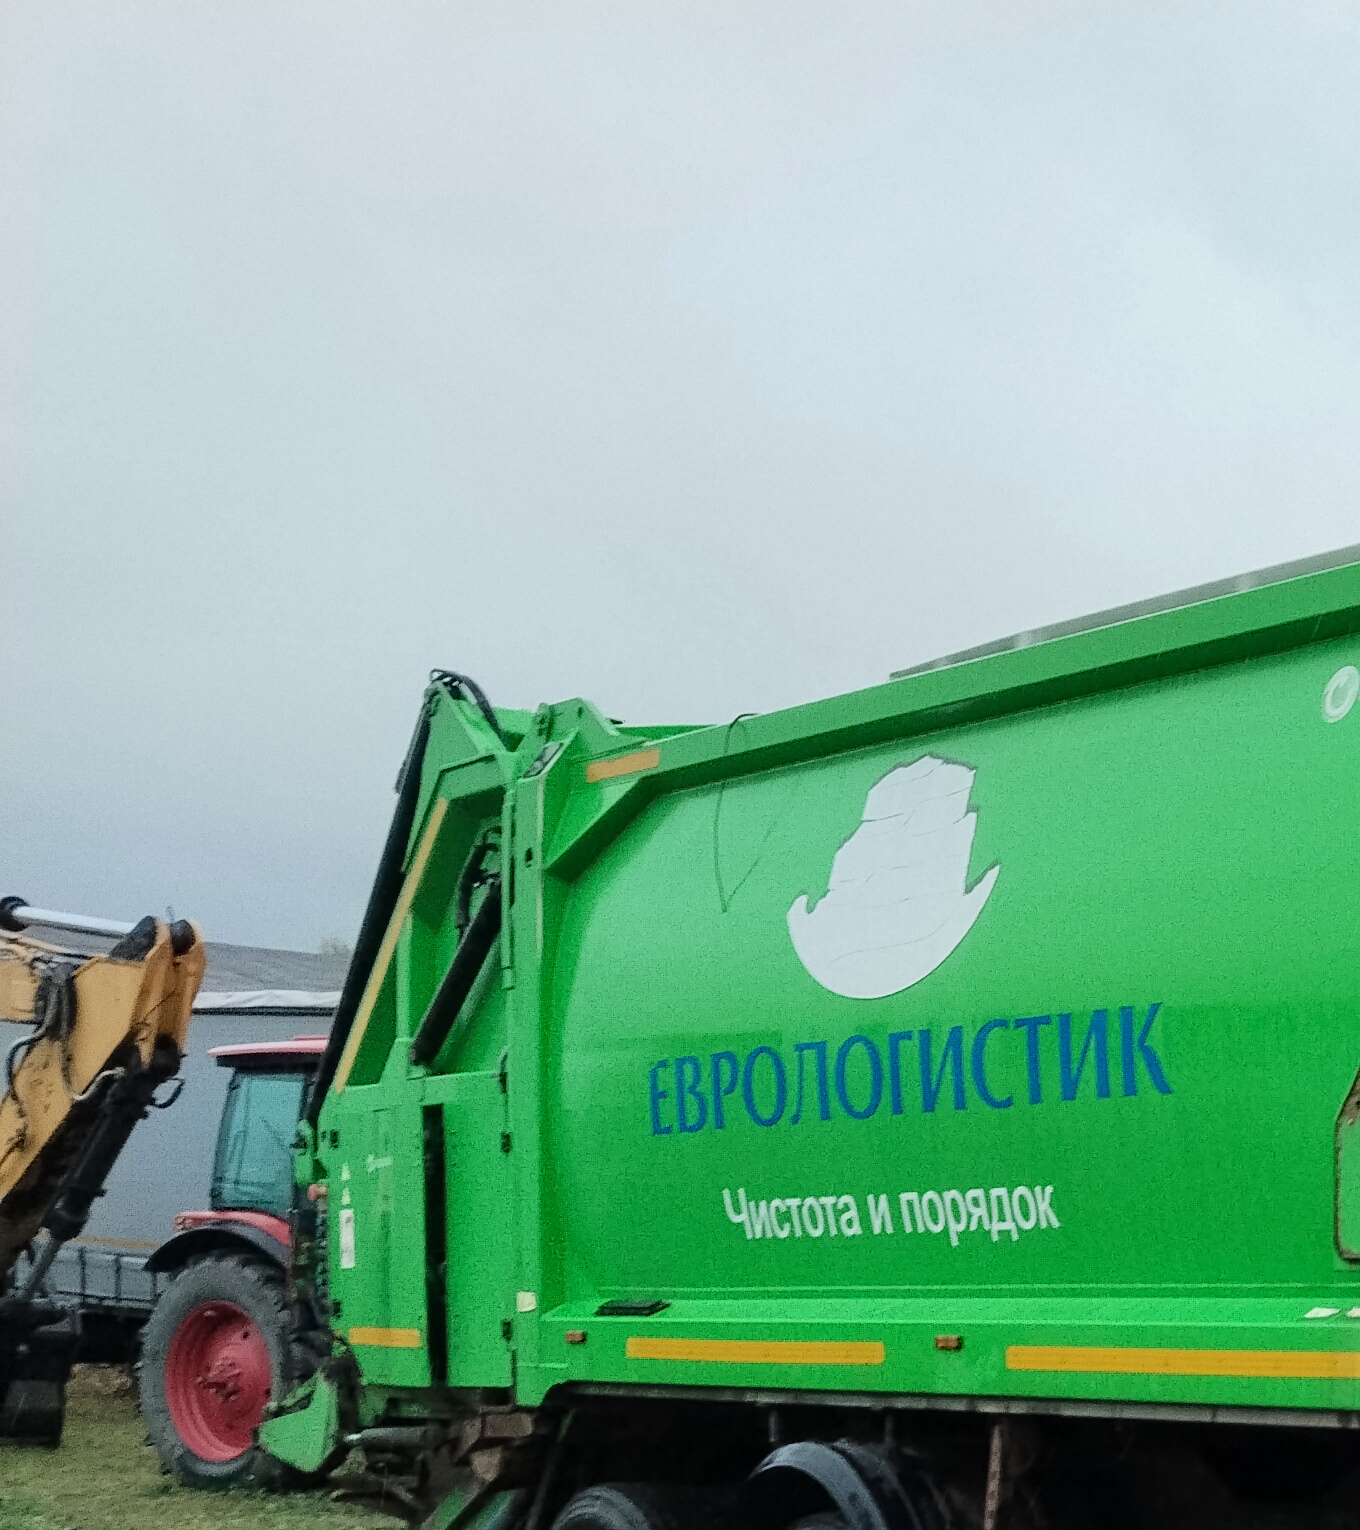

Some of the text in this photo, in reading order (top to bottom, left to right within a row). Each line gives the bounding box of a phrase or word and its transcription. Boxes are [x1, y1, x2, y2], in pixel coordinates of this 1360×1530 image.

[648, 1002, 1173, 1137] ЕВРОЛОГИСТИК
[722, 1184, 1061, 1247] Чистота и порядок
